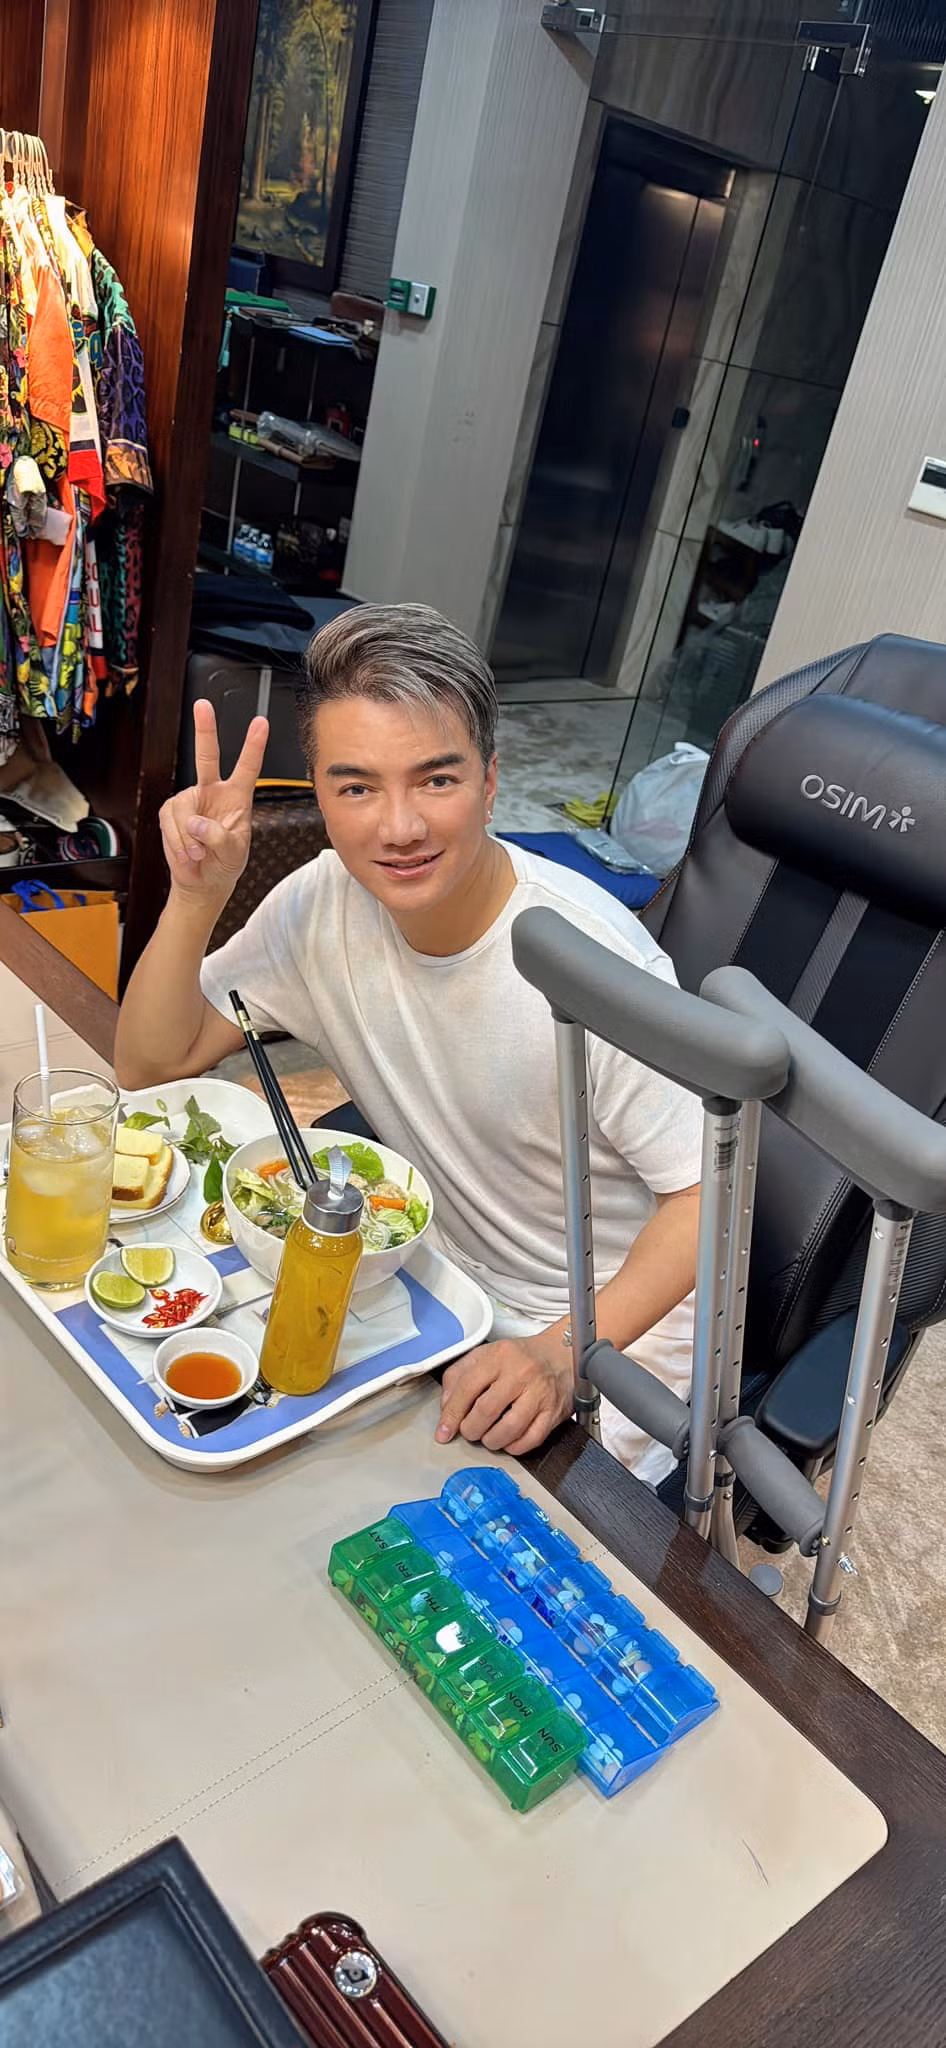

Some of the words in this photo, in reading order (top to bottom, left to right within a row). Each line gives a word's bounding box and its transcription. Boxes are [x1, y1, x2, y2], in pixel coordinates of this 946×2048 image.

[800, 774, 887, 830] OSIM
[368, 1530, 388, 1550] SAT
[395, 1561, 413, 1579] FRI
[420, 1591, 441, 1613] THU
[478, 1656, 497, 1680] TUE
[506, 1691, 532, 1718] MON
[538, 1727, 562, 1753] SUN
